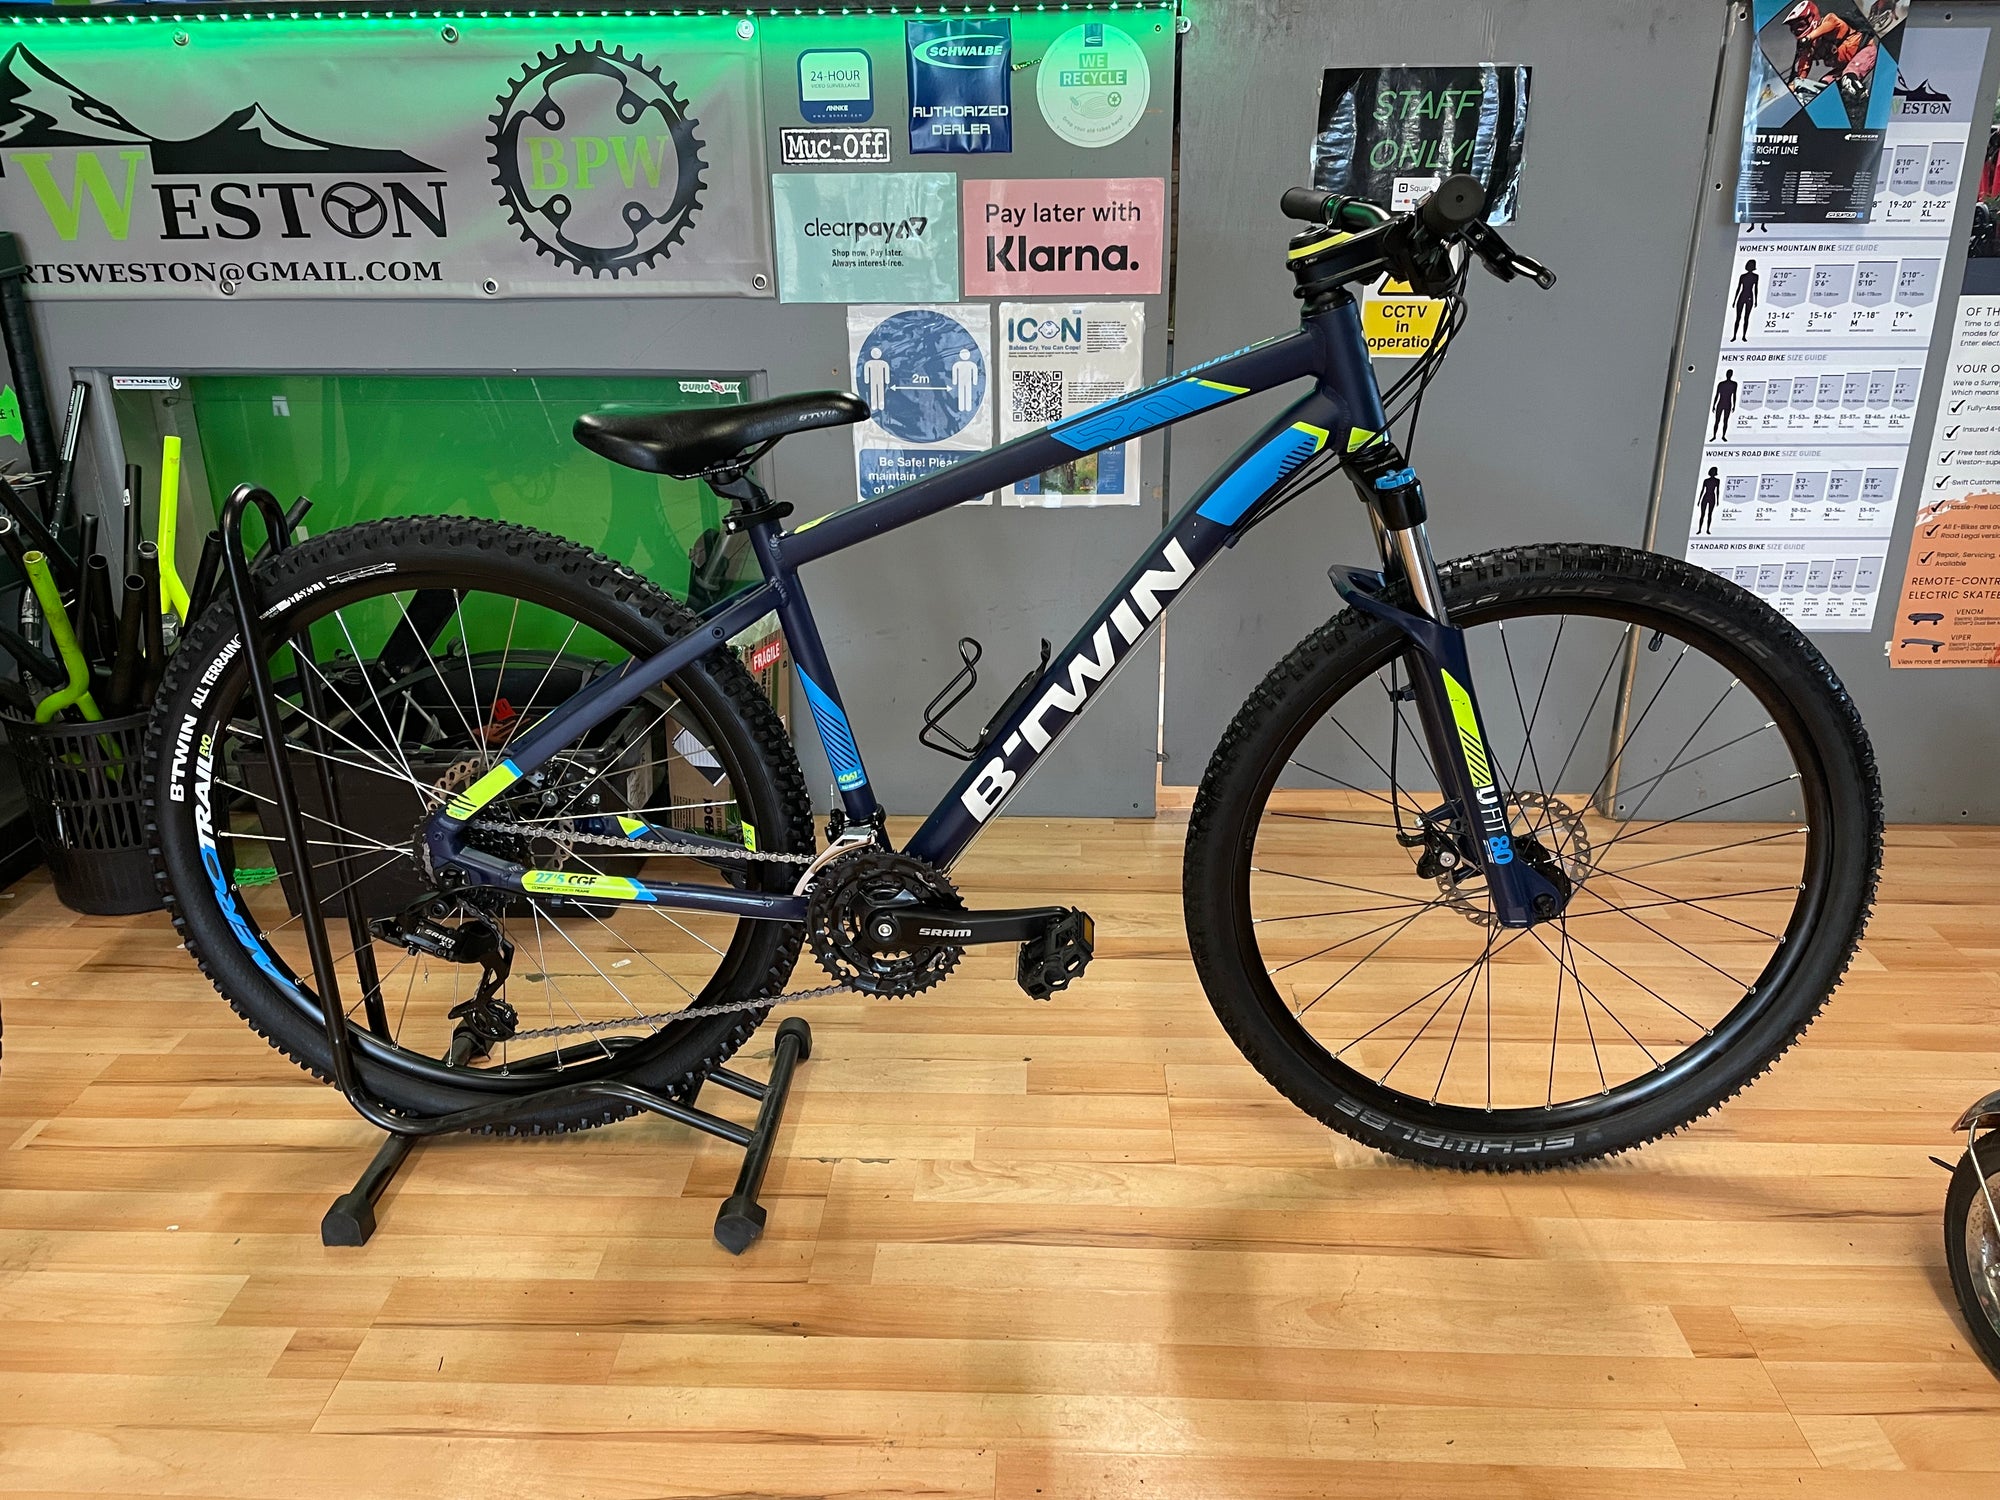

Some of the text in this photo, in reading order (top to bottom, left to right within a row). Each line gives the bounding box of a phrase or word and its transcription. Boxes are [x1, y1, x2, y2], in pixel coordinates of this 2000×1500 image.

[929, 44, 1003, 57] SCHWALBE
[1082, 54, 1104, 68] WE
[810, 70, 860, 81] 24-HOUR
[1063, 72, 1124, 85] RECYCLE
[913, 104, 1008, 118] AUTHORIZED
[1372, 90, 1483, 121] STAFF
[932, 122, 991, 135] DEALER
[787, 133, 885, 158] Muc-Off
[1768, 135, 1798, 143] TIPPIE
[1369, 140, 1475, 168] ONLY!
[1756, 146, 1799, 155] RIGHT LINE
[523, 135, 676, 191] BPW
[10, 151, 448, 240] WESTON
[1889, 200, 1917, 208] 19-20"
[1922, 200, 1951, 208] 21-22"
[985, 202, 1141, 227] Pay later with
[804, 217, 895, 244] clearpay
[832, 249, 849, 257] Shop
[870, 249, 883, 258] Pay
[884, 249, 903, 257] later.
[987, 235, 1139, 273] Klarna.
[1739, 244, 1775, 252] WOMEN'S
[1776, 244, 1817, 252] MOUNTAIN
[1818, 244, 1836, 252] BIKE
[832, 259, 856, 268] Always
[1382, 305, 1428, 318] CCTV
[1966, 307, 1982, 316] OF
[1396, 320, 1409, 333] in
[1765, 320, 1777, 328] XS
[1807, 320, 1813, 328] S
[1367, 335, 1433, 350] operatio
[1956, 364, 1987, 373] YOUR
[912, 374, 930, 384] 2m
[879, 457, 958, 467] Be Safe! Plea
[868, 472, 916, 481] maintain
[873, 485, 884, 494] of
[1908, 590, 1959, 599] ELECTRIC
[753, 642, 780, 669] FRAGILE
[191, 639, 242, 709] ALL TERRAIN
[199, 734, 212, 757] EVO
[1488, 835, 1513, 864] 80
[568, 875, 597, 885] CGF
[424, 929, 456, 945] SRAM
[918, 927, 972, 938] SRAM
